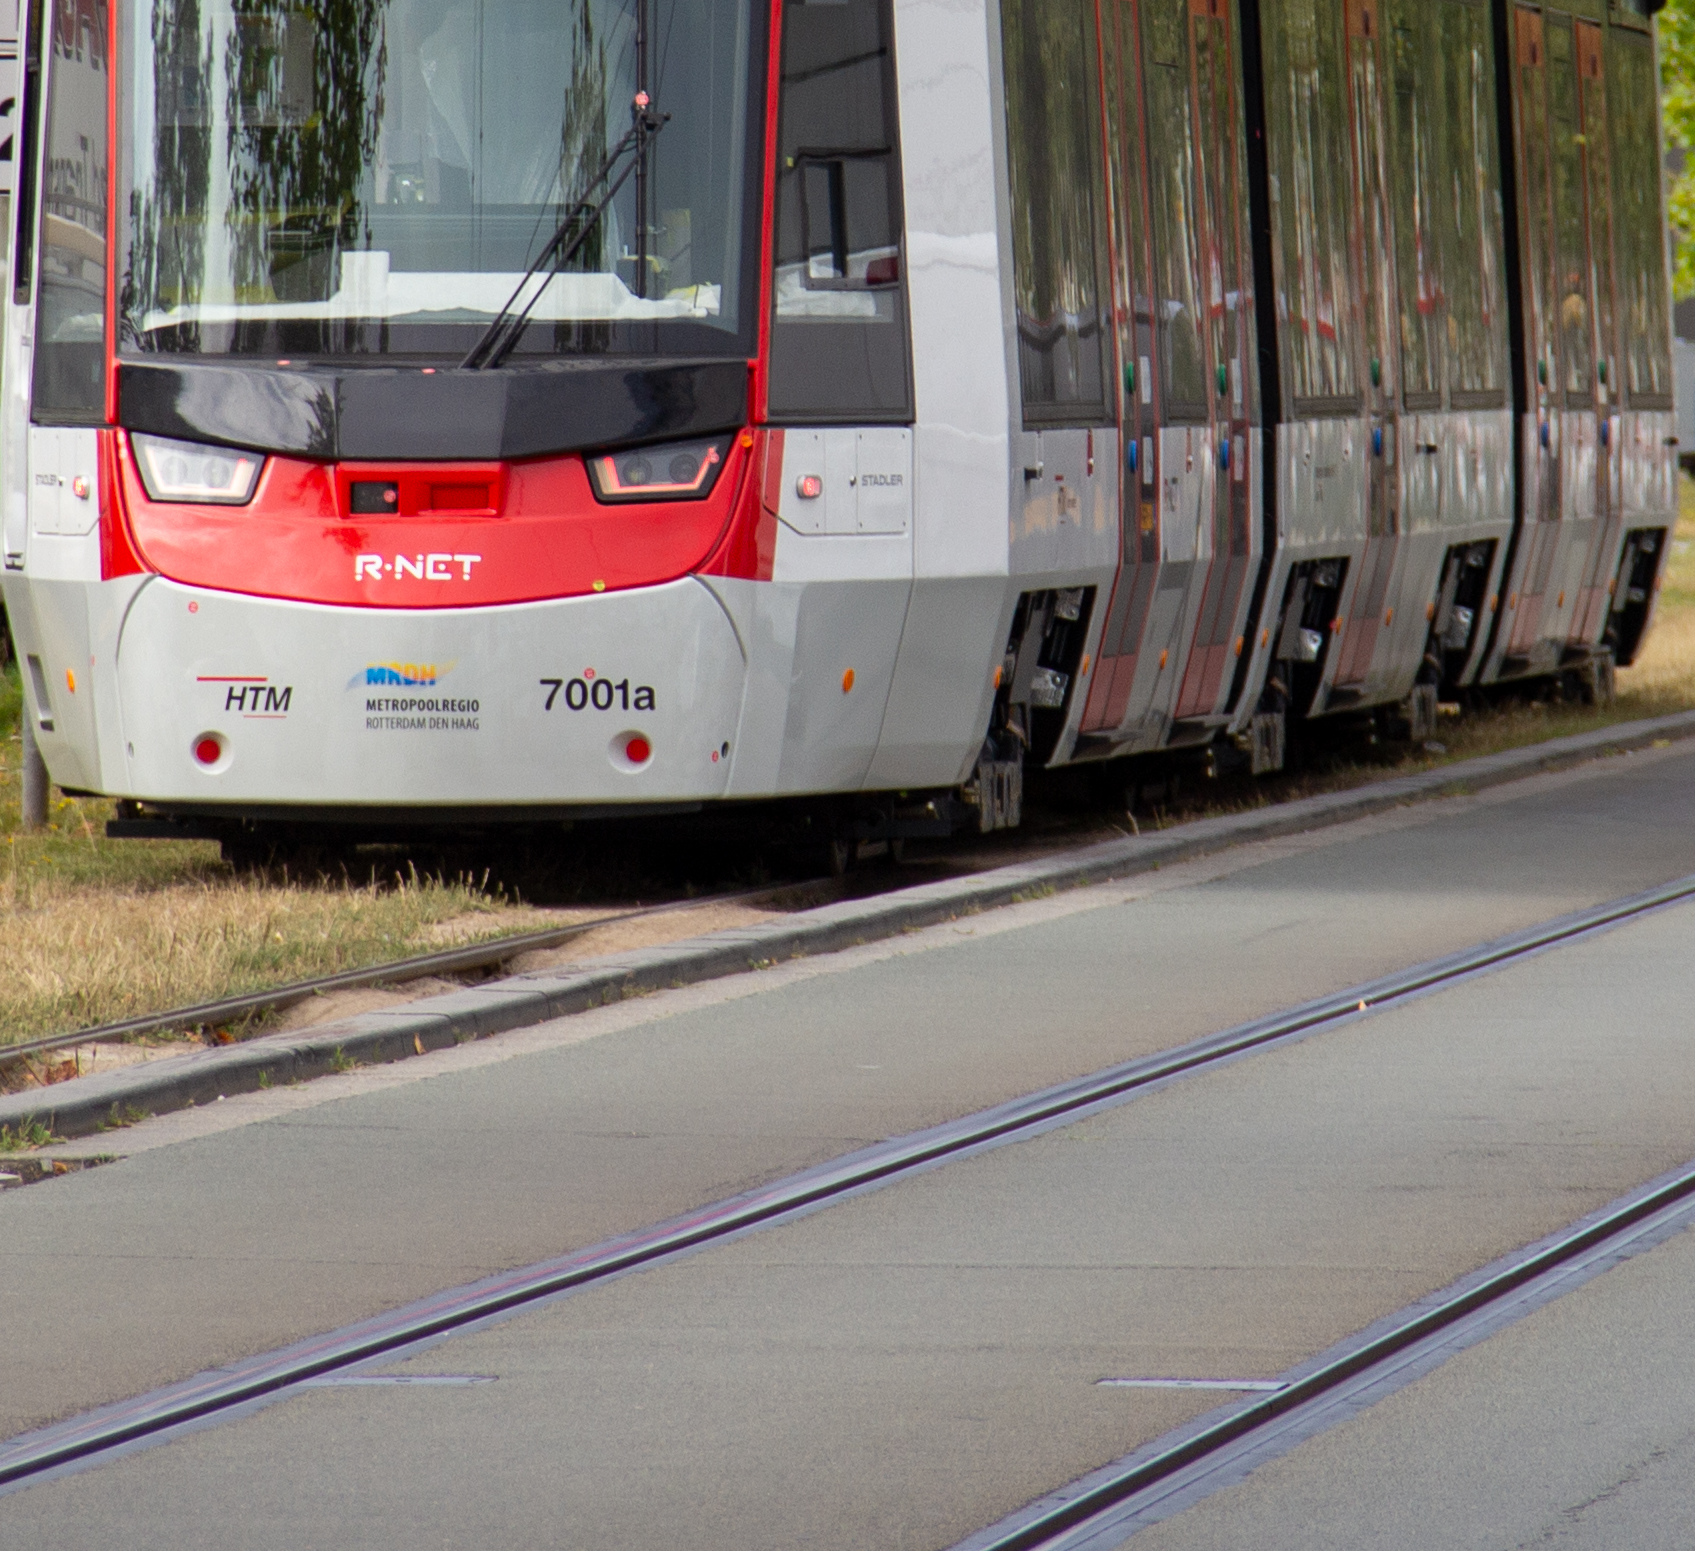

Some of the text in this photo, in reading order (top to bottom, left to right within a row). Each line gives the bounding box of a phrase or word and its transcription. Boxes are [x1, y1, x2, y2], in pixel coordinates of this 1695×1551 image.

[861, 474, 904, 486] STADLER
[366, 662, 437, 686] MRDH
[225, 686, 293, 711] HTM
[539, 678, 656, 711] 7001a
[366, 698, 480, 712] METROPOOLREGIO
[366, 717, 480, 730] ROTTERDAM DEN HAAG
